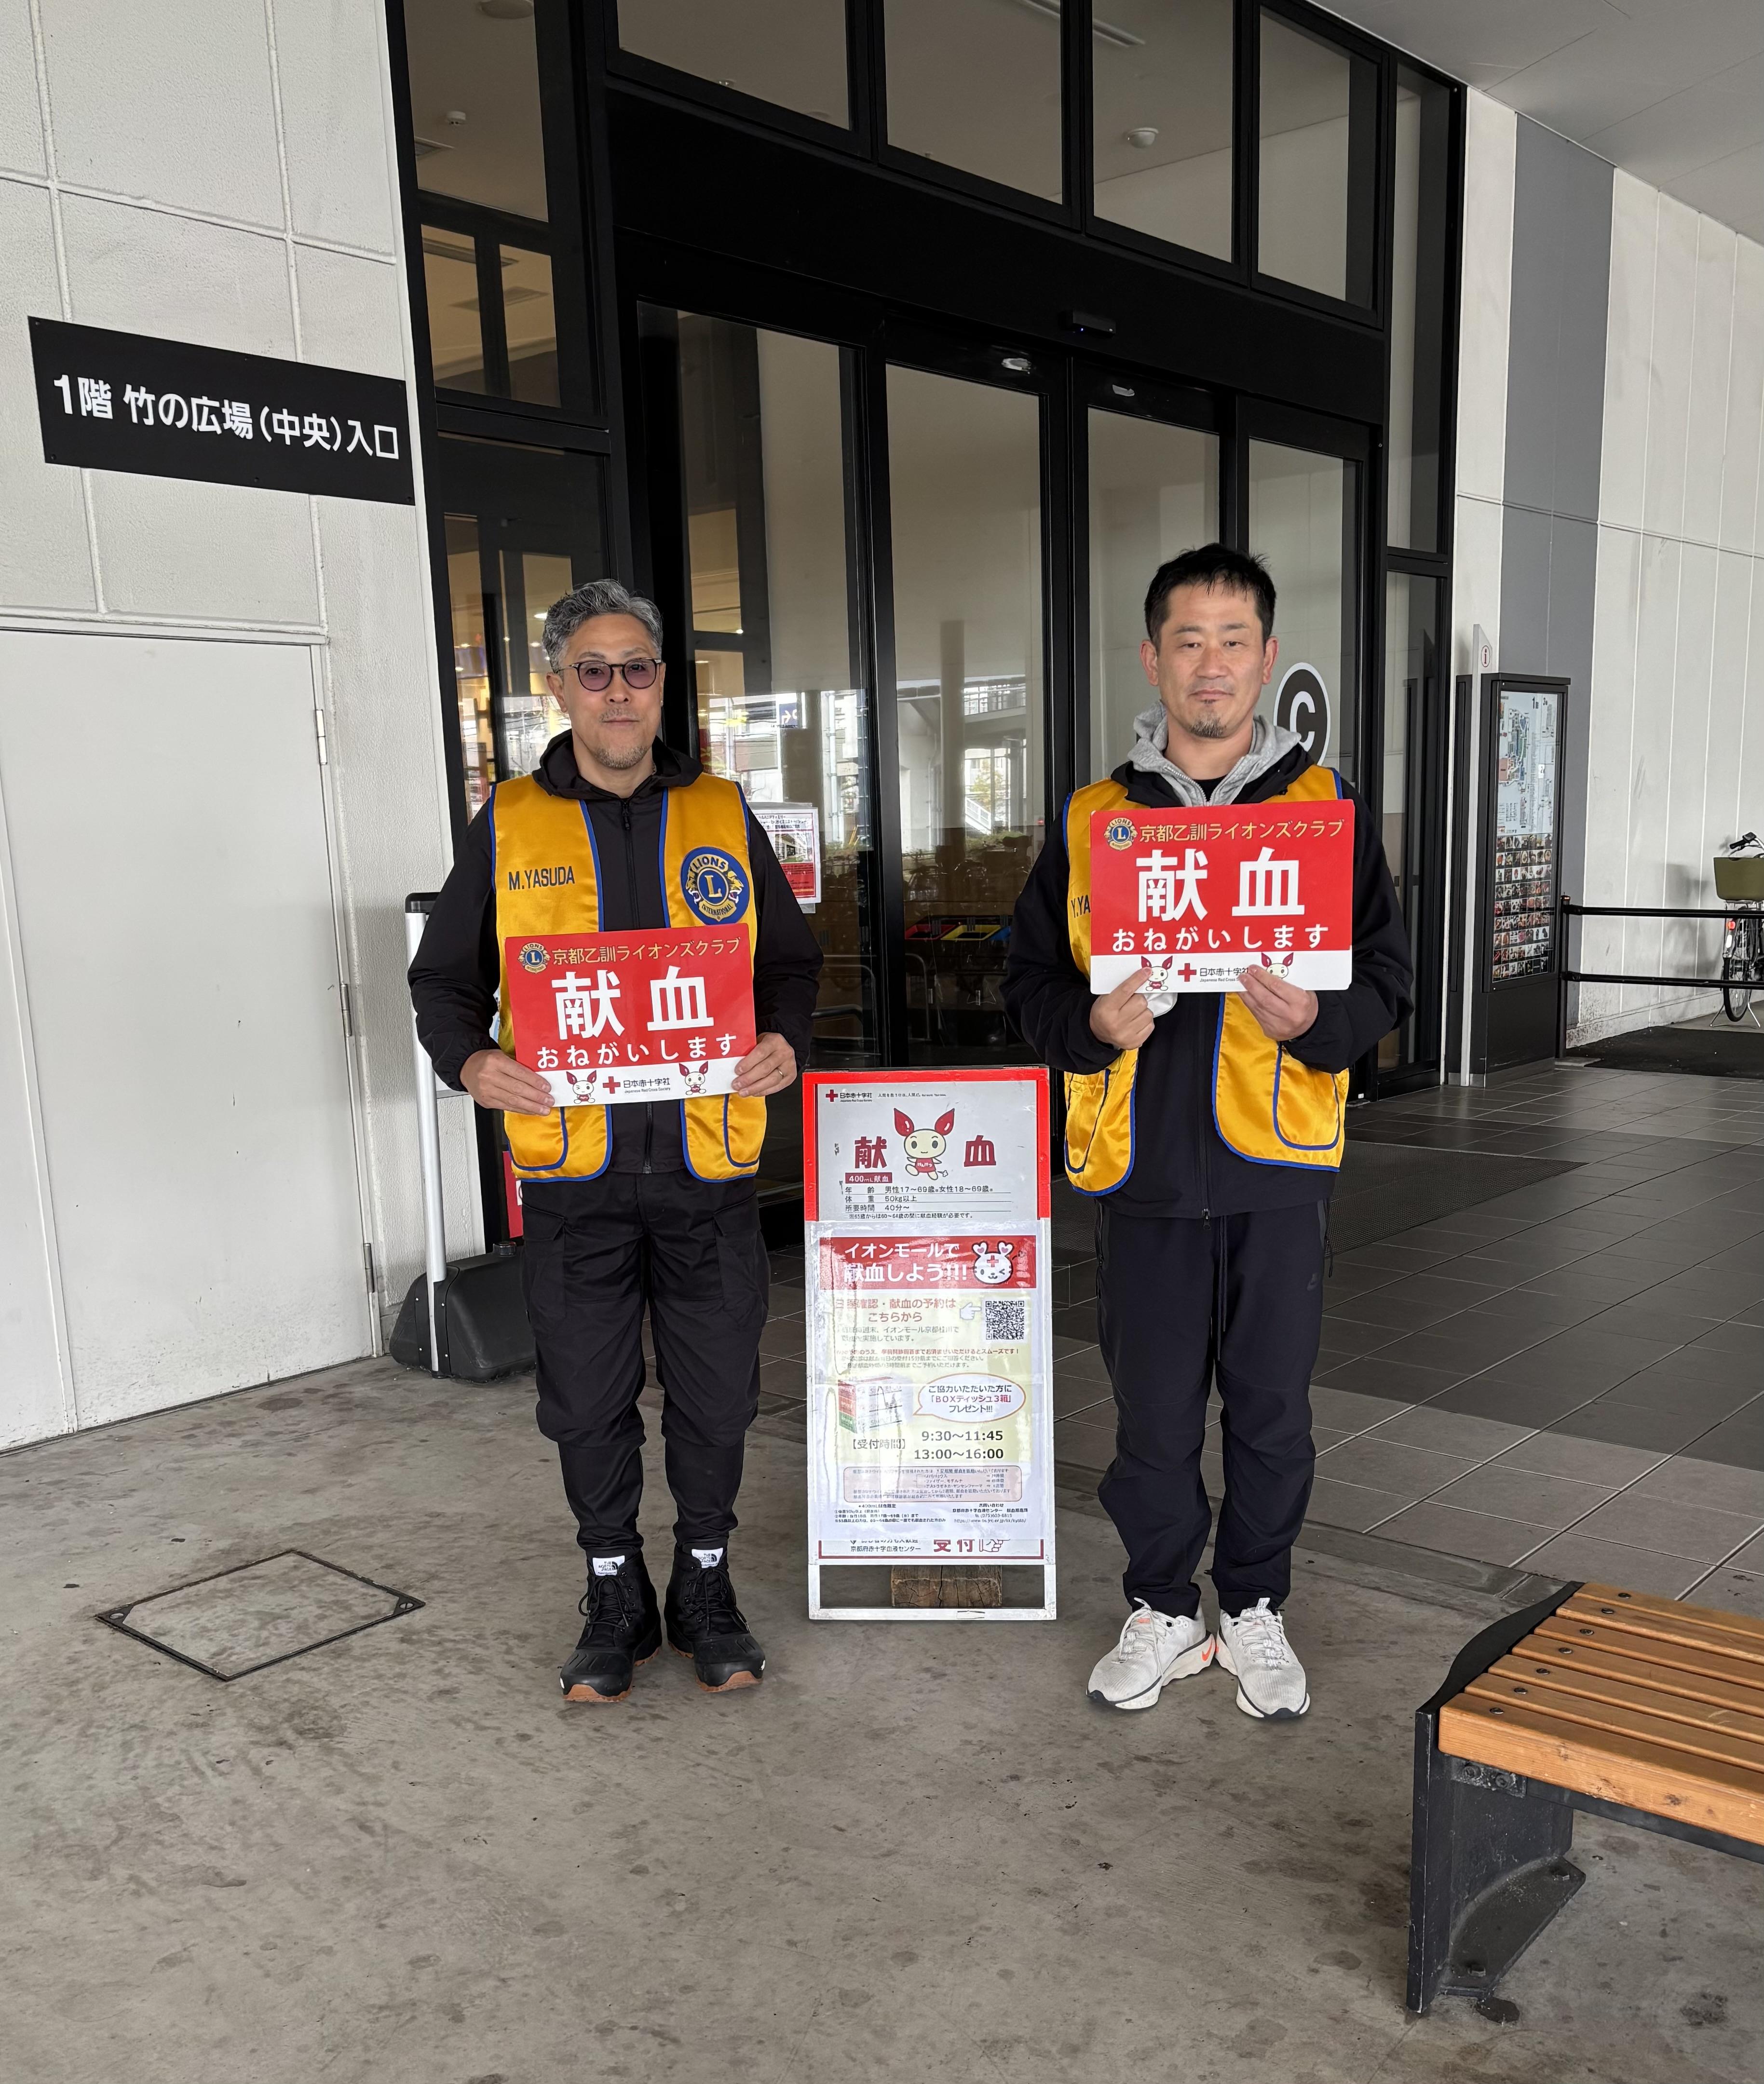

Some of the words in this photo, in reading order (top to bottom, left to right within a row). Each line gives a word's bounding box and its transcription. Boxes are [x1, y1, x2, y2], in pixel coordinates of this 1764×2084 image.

[54, 374, 113, 420] 1階
[123, 384, 399, 460] 竹の広場（中央）入口
[1290, 691, 1316, 752] C
[1140, 819, 1344, 843] 京都乙訓ライオンズクラブ
[692, 856, 727, 871] LIONS
[508, 866, 575, 891] M.YASUDA
[705, 875, 722, 897] L
[1136, 846, 1305, 923] 献血
[1113, 924, 1329, 952] おねがいします
[552, 937, 741, 965] 京都乙訓ライオンズクラブ
[551, 965, 714, 1041] 献血
[537, 1033, 737, 1069] おねがいします
[624, 1078, 670, 1088] 日本赤十字社
[845, 1243, 960, 1258] イオンモールで
[868, 1312, 923, 1322] こちらから
[922, 1431, 1003, 1441] 9:30～11:45
[914, 1448, 1004, 1459] 13:00～16:00
